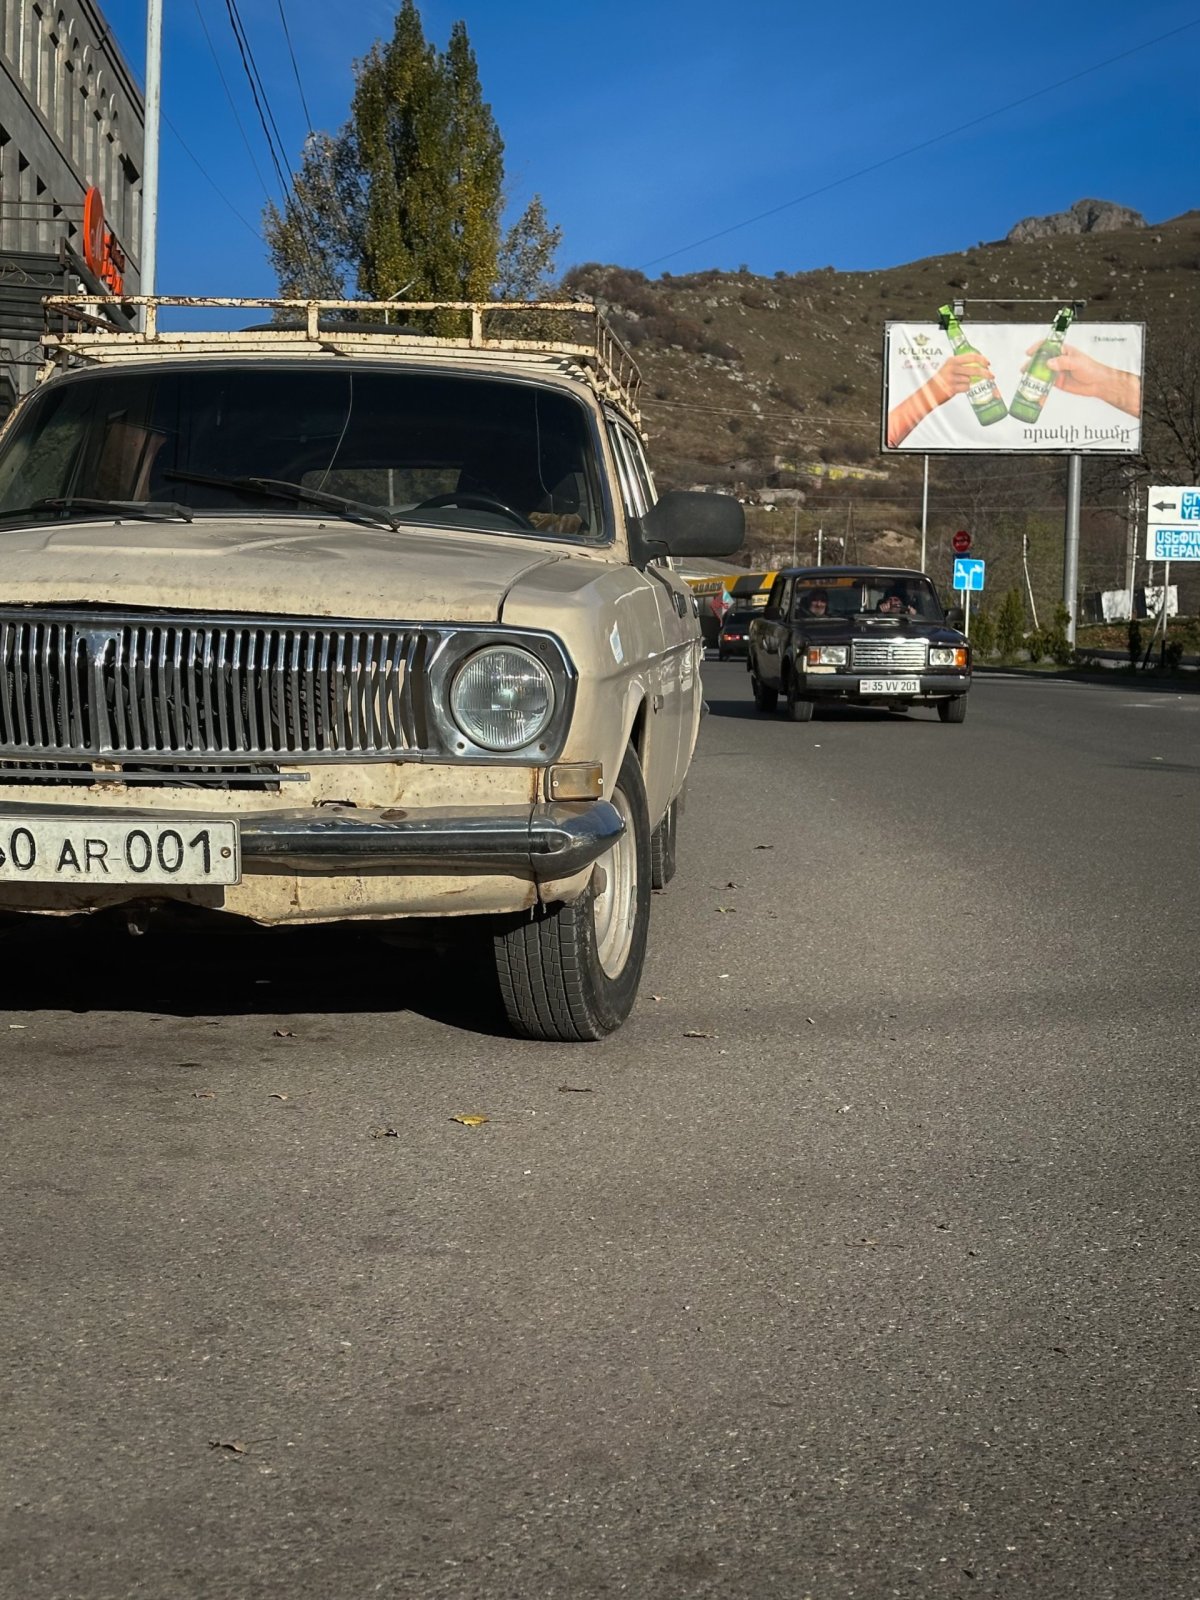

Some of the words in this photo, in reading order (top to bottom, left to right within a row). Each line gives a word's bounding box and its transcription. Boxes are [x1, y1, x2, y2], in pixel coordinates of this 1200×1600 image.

[898, 347, 943, 356] KLIKIA
[872, 681, 883, 691] 35
[900, 681, 917, 691] 201
[0, 828, 36, 871] 0
[56, 838, 110, 873] AR
[125, 829, 212, 874] 001
